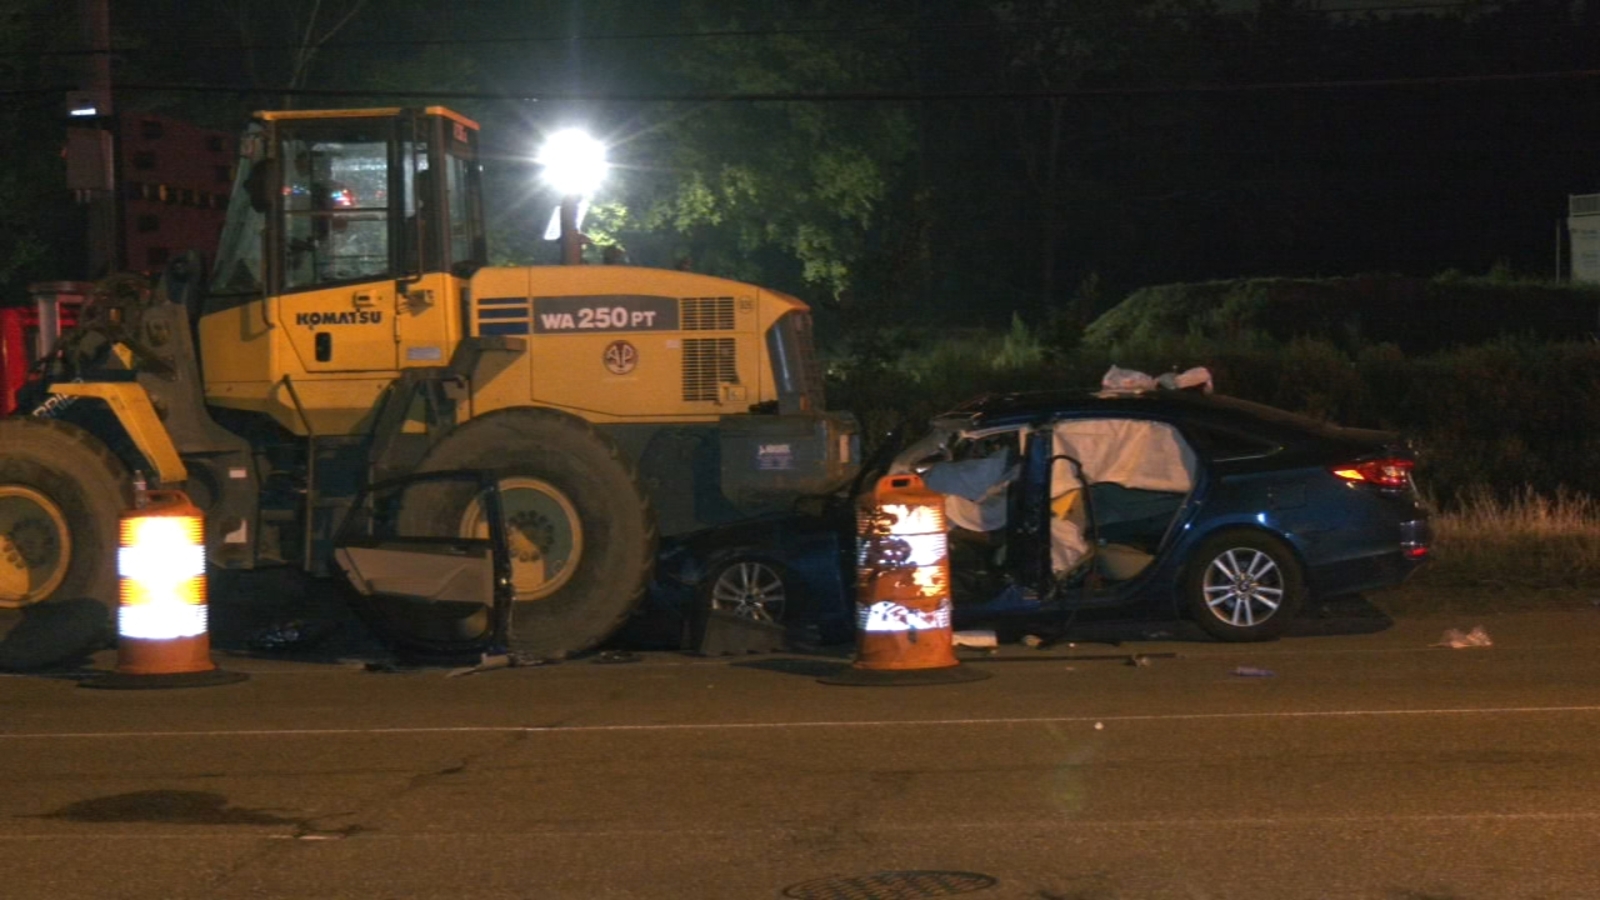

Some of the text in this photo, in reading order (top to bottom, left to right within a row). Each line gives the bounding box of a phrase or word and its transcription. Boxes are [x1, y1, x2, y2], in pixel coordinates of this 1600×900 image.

[296, 310, 382, 326] KOMATSU
[541, 307, 656, 329] WA 250 PT
